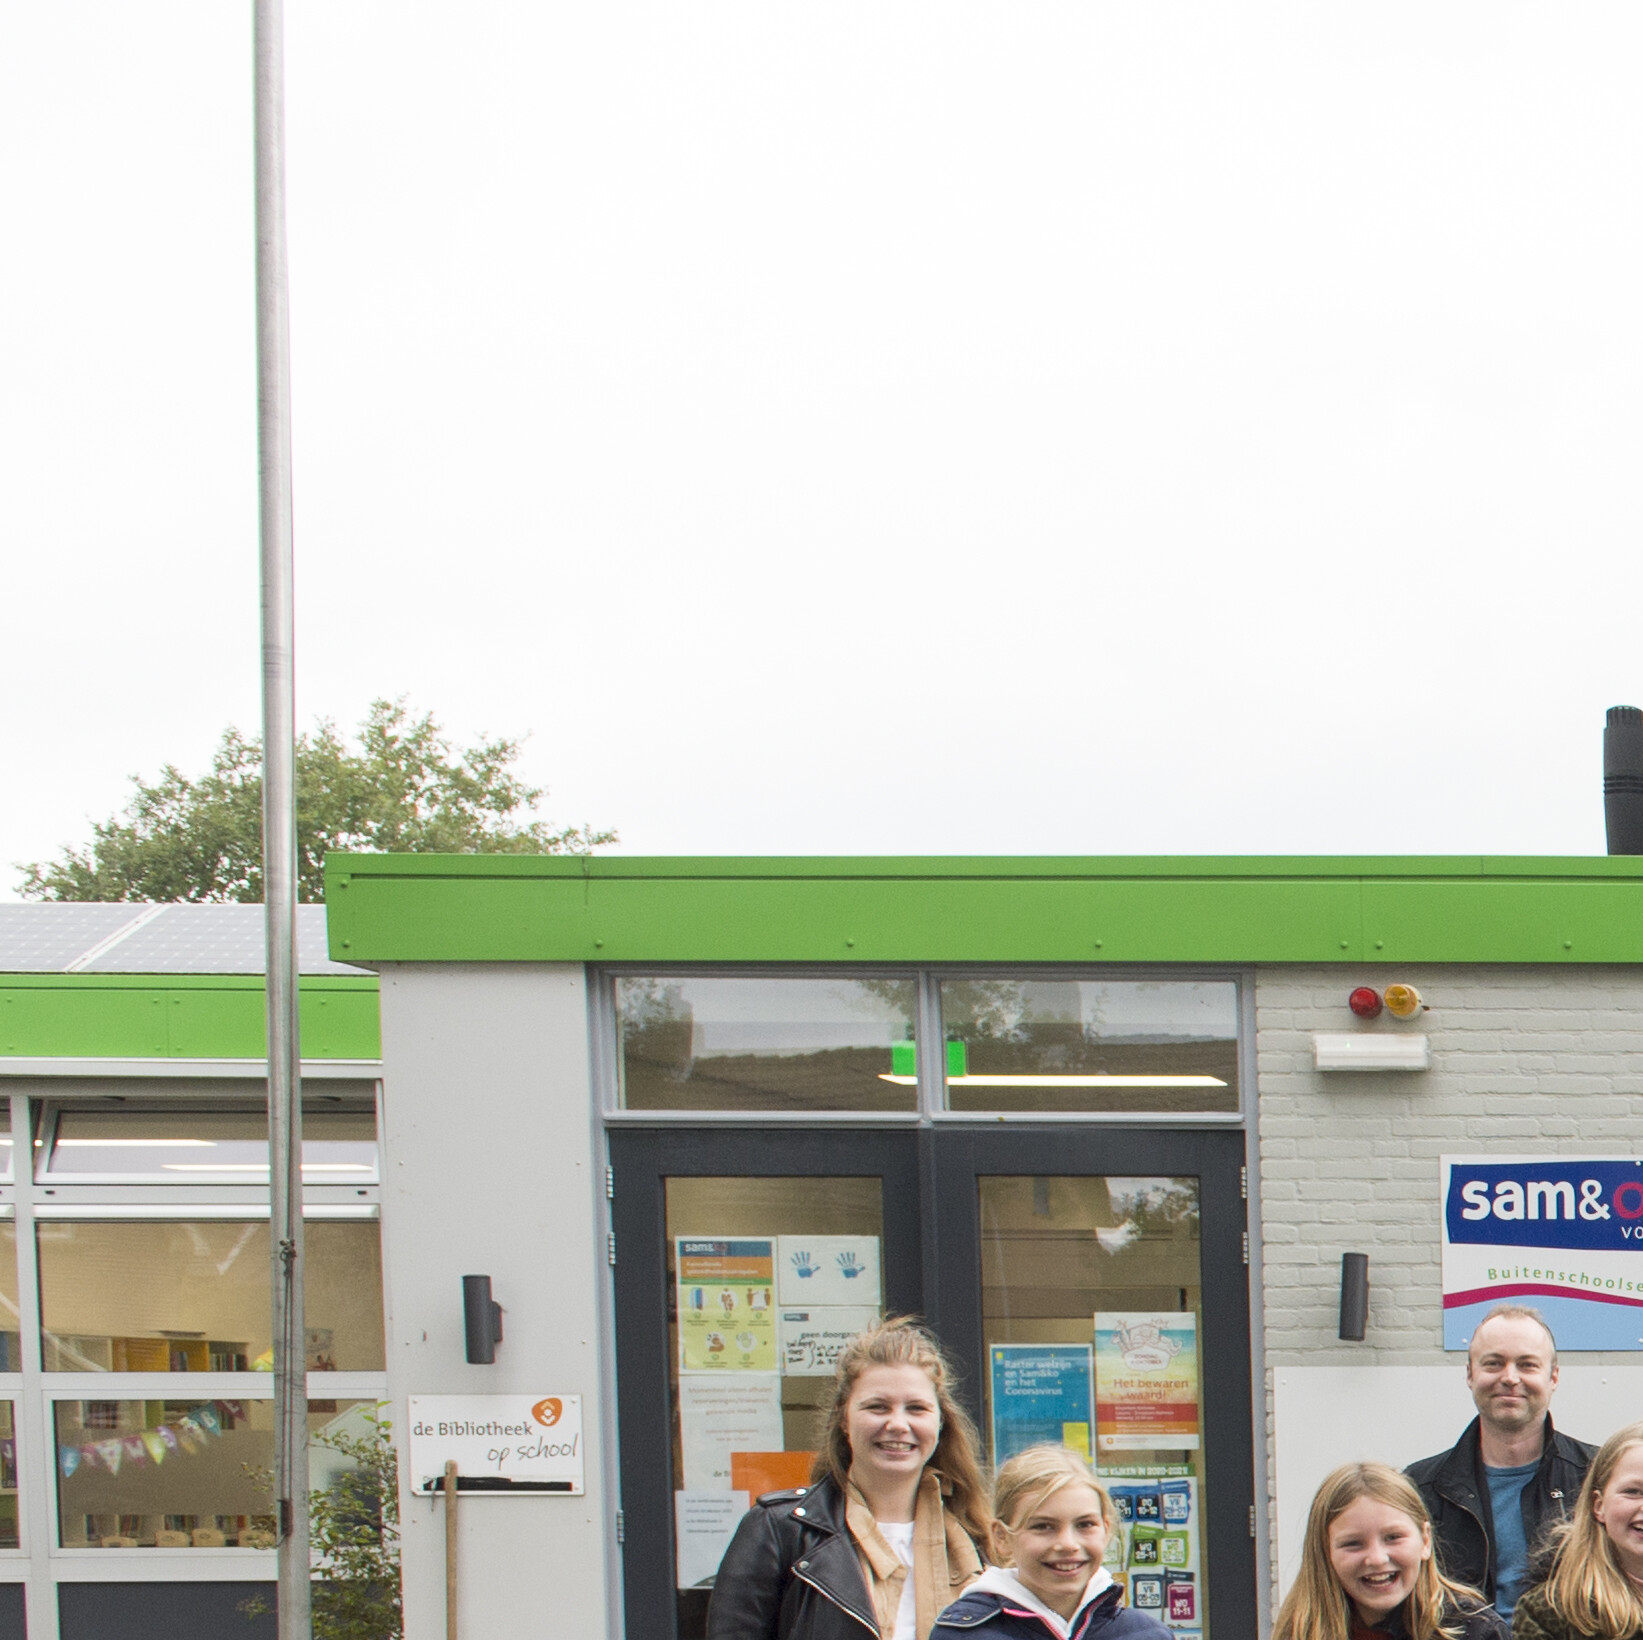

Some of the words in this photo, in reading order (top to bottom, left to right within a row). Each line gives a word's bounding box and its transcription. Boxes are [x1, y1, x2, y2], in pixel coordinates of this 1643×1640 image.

[1113, 1379, 1135, 1388] Het
[1137, 1378, 1189, 1388] bewaren
[1005, 1387, 1063, 1395] Coronavirus
[413, 1421, 434, 1436] de
[438, 1421, 533, 1436] Bibliotheek
[487, 1446, 510, 1471] op
[517, 1433, 579, 1461] school
